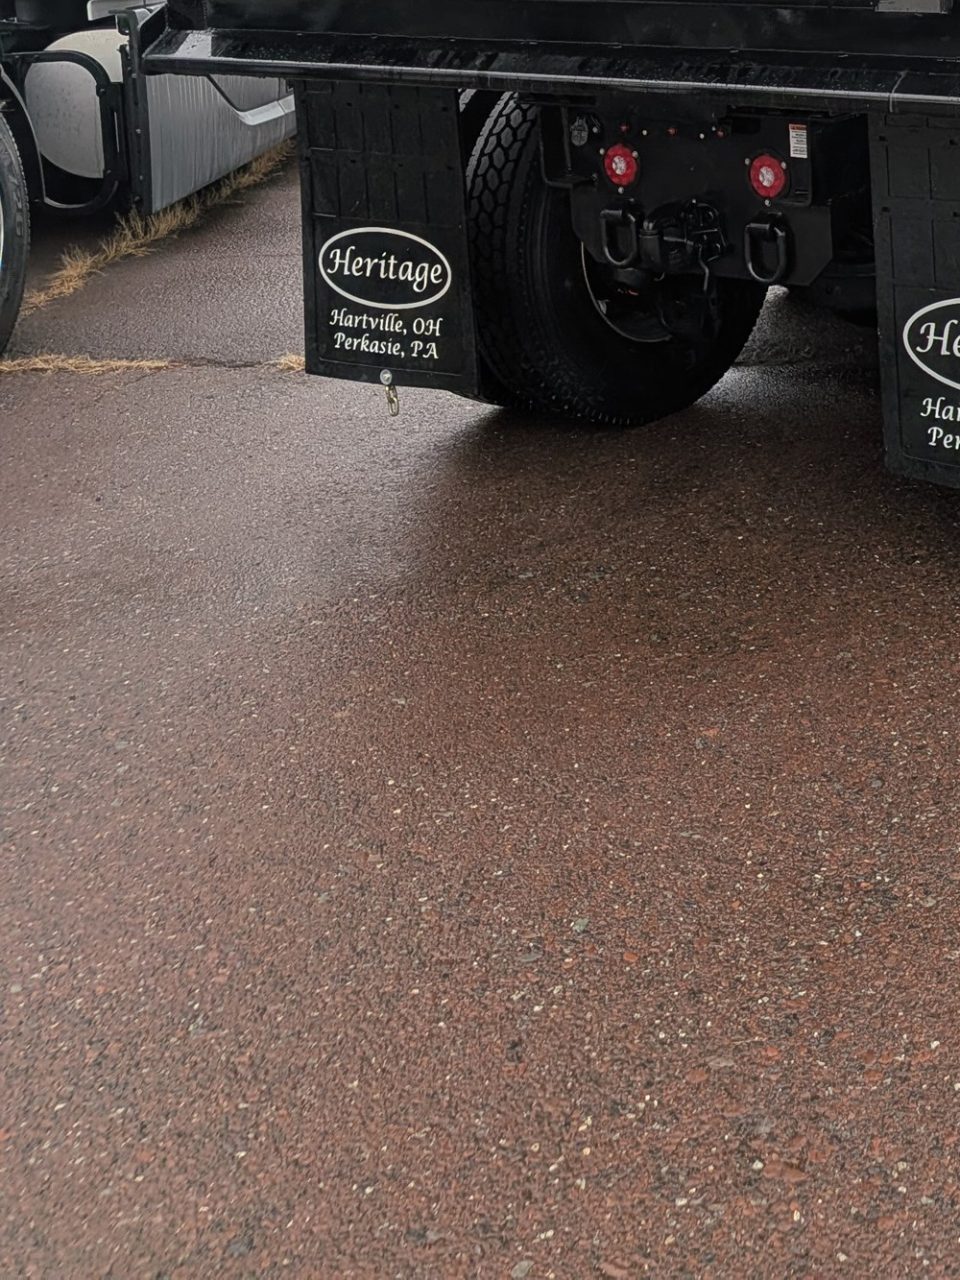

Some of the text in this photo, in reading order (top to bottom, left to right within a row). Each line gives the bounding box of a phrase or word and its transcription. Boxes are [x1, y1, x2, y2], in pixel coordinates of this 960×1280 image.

[327, 245, 443, 293] Heritage
[329, 308, 444, 337] Hartville, OH
[333, 331, 439, 359] Perkasie, PA
